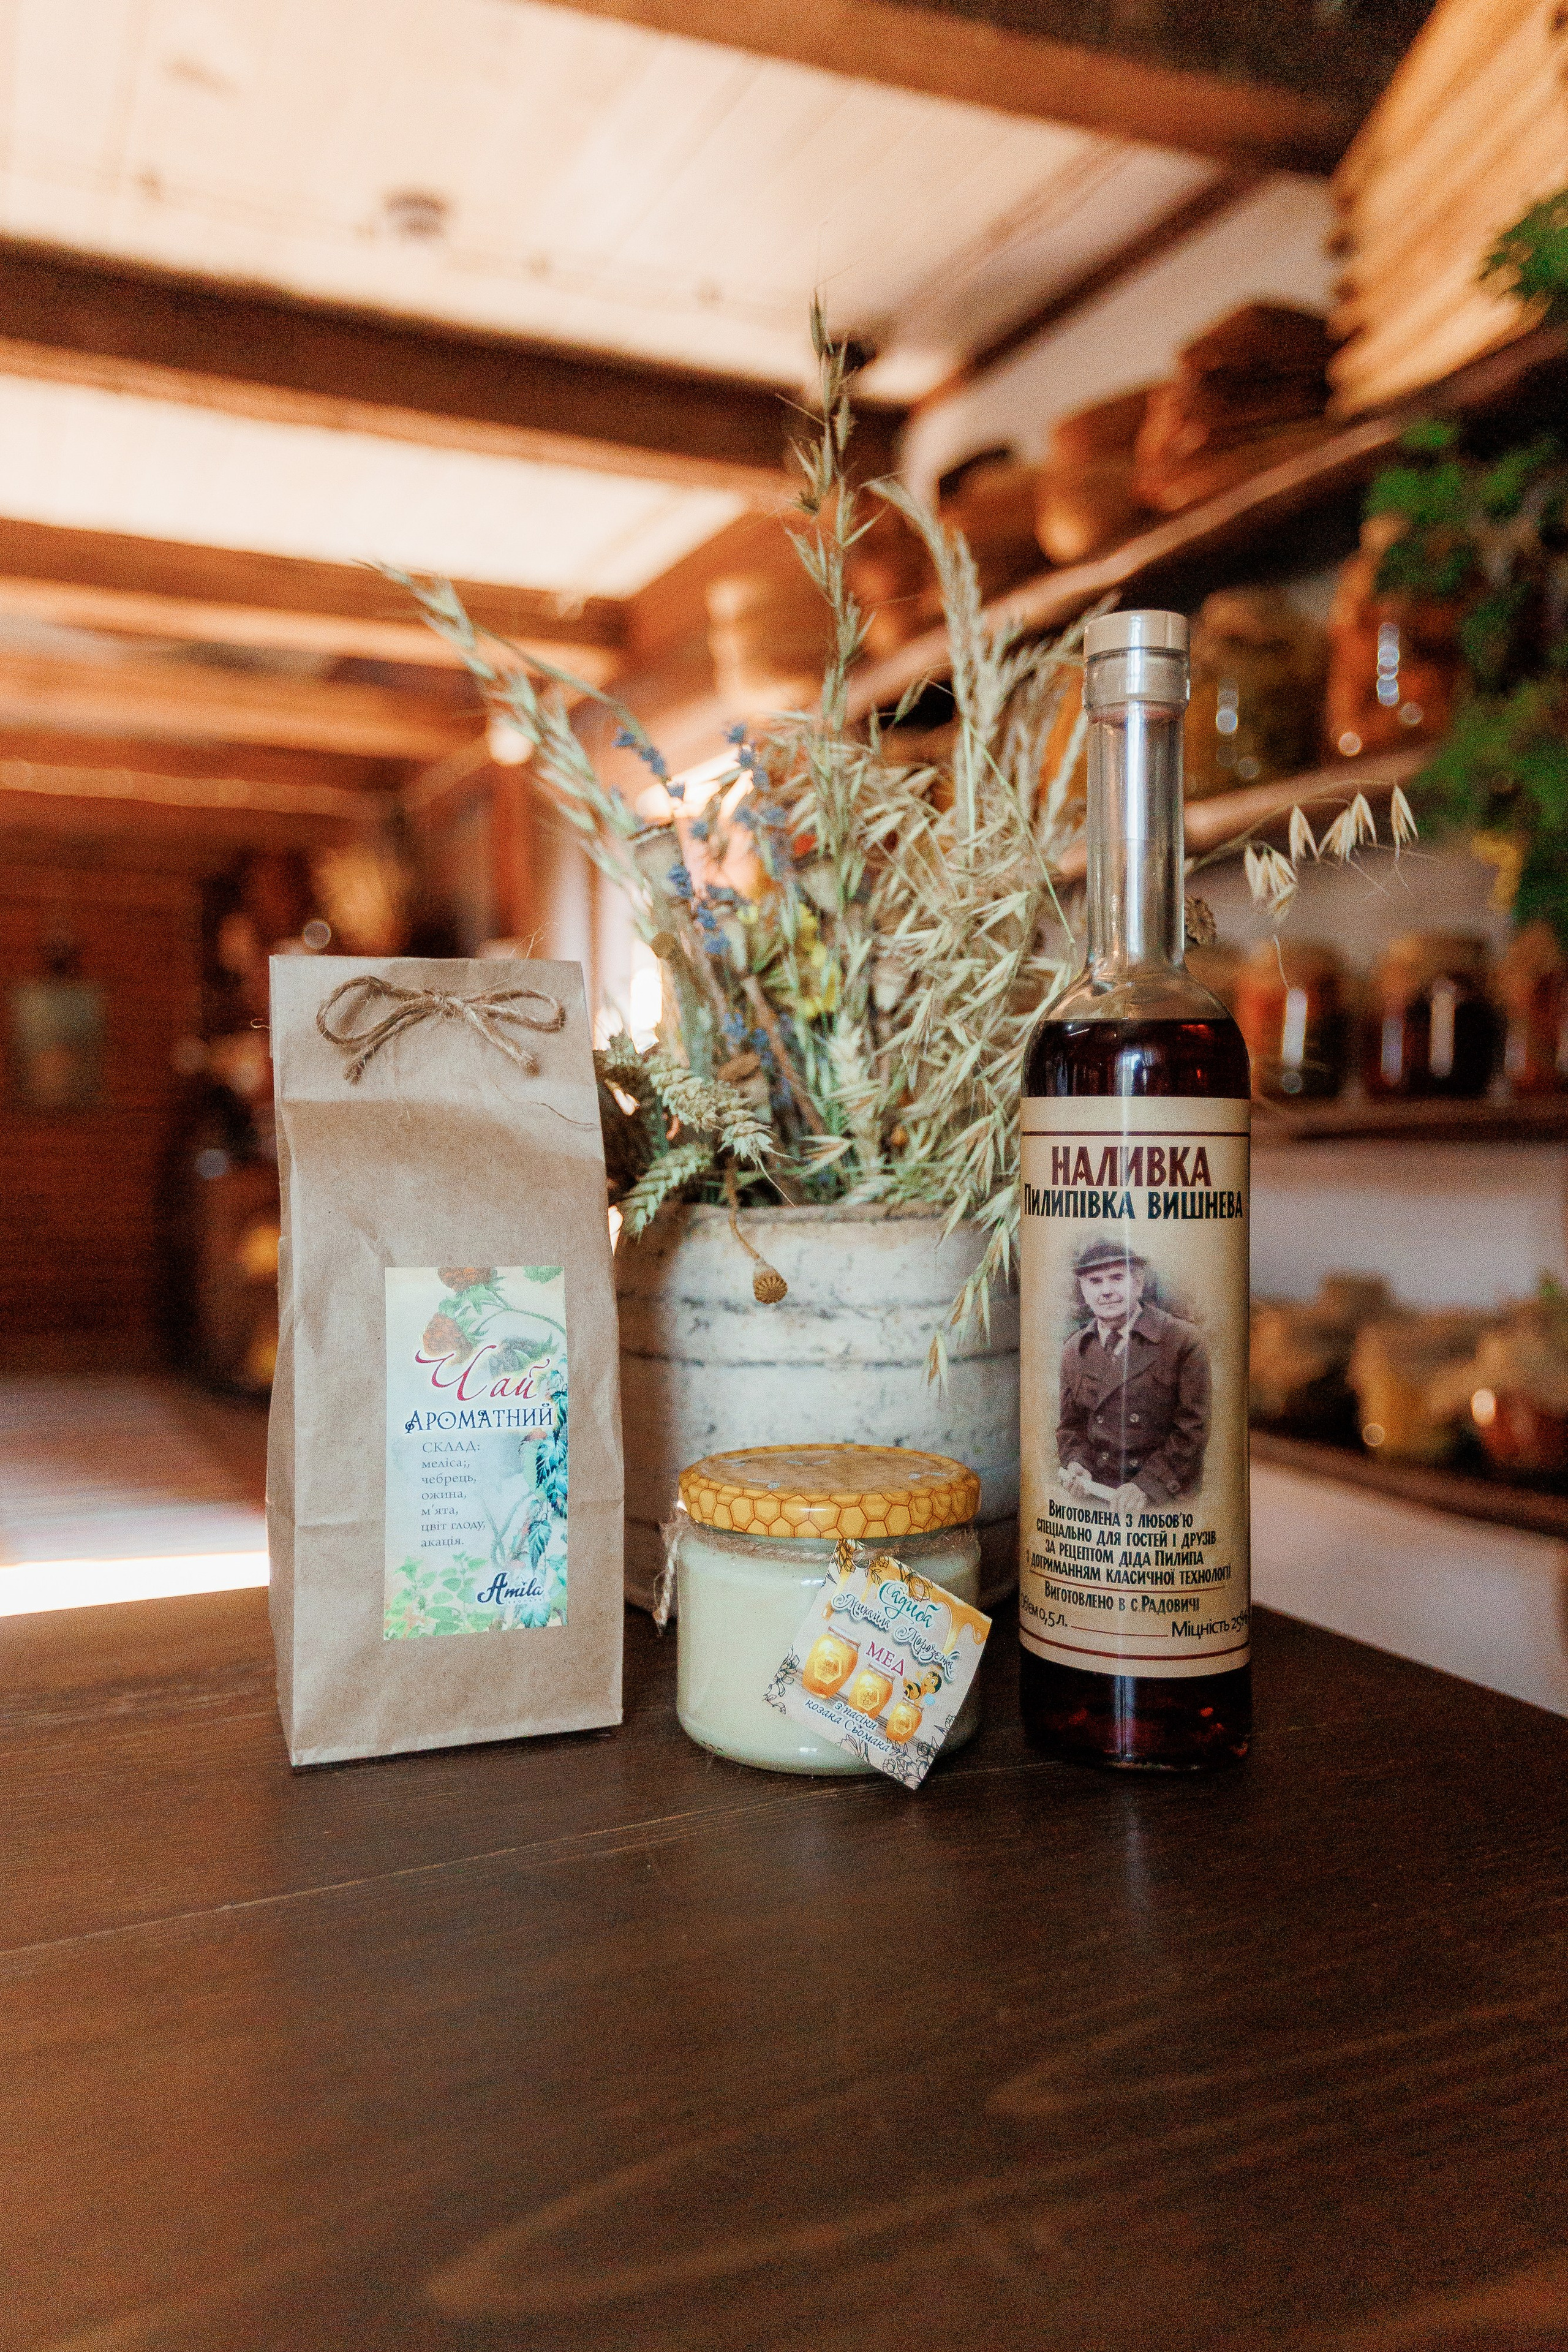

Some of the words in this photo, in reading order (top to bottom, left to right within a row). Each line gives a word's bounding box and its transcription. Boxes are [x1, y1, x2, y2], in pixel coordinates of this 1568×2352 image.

[1051, 1145, 1212, 1187] НАЛИВКА
[1023, 1183, 1136, 1219] ПИЛИПІВКА
[1147, 1191, 1243, 1219] ВИШНЕВА
[415, 1344, 550, 1401] Чай
[404, 1403, 554, 1434] АРОМАТНИЙ
[422, 1441, 480, 1453] СКЛАД:
[421, 1472, 477, 1486] чебрець,
[421, 1491, 467, 1501] ожина,
[421, 1521, 447, 1532] цвіт
[451, 1520, 486, 1531] глоду,
[421, 1536, 464, 1547] акація.
[1036, 1517, 1092, 1542] СПЕЦІАЛЬНО
[1096, 1529, 1121, 1547] ДЛЯ
[1126, 1530, 1167, 1547] ГОСТЕЙ
[1180, 1531, 1217, 1549] ДРУЗІВ
[1031, 1552, 1101, 1581] ДОТРИМАННЯМ
[1106, 1568, 1175, 1585] КЛАСИЧНОЇ
[1045, 1539, 1055, 1555] ЗА
[1059, 1542, 1114, 1564] РЕЦЕПТОМ
[1118, 1550, 1152, 1568] ДІДА
[477, 1572, 545, 1605] Amila
[878, 1581, 941, 1628] Садиба
[1172, 1618, 1230, 1640] Міцність
[865, 1640, 905, 1677] МЕД
[805, 1700, 842, 1724] козака
[844, 1719, 891, 1752] Сьомака
[843, 1706, 877, 1730] пасіки
